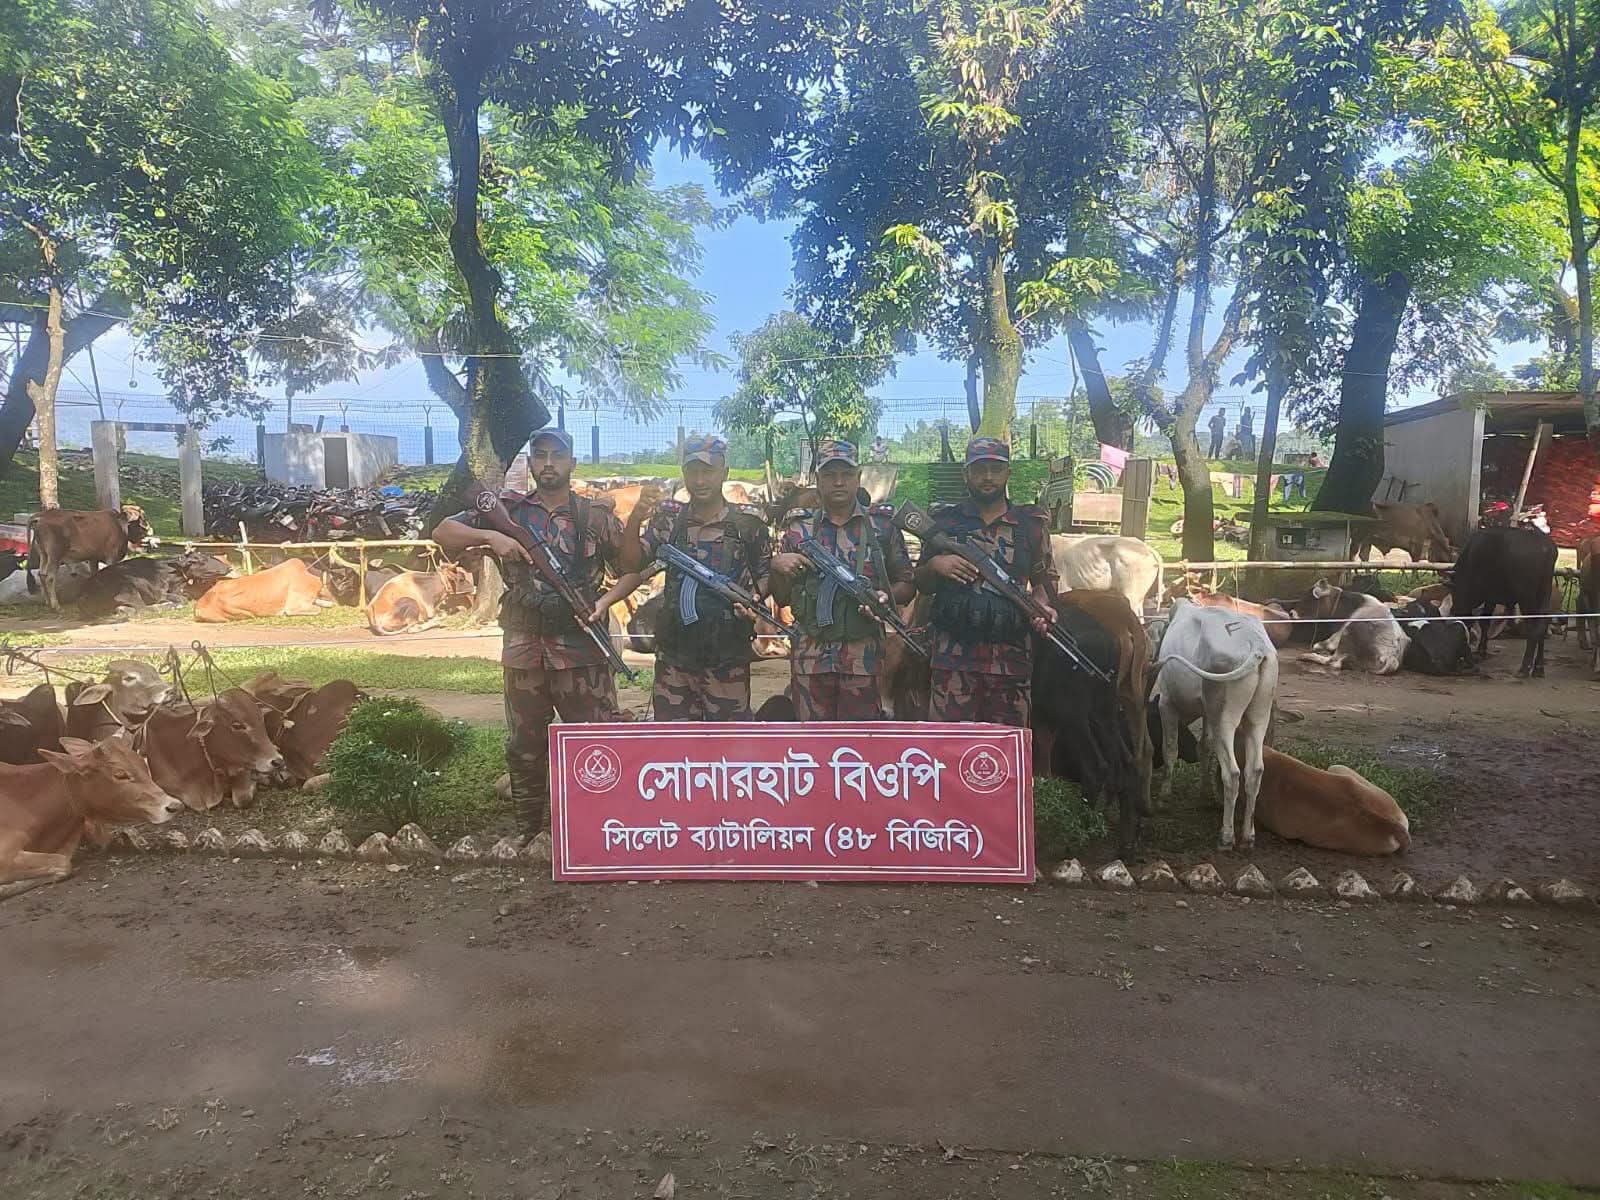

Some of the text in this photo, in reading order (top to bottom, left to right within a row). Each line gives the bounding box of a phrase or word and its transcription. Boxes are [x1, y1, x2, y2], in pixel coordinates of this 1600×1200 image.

[637, 746, 947, 807] সোনারহাট বিওপি
[601, 817, 984, 859] সিলেট ব্যাটালিয়ন (৪৮ বিজিবি)
